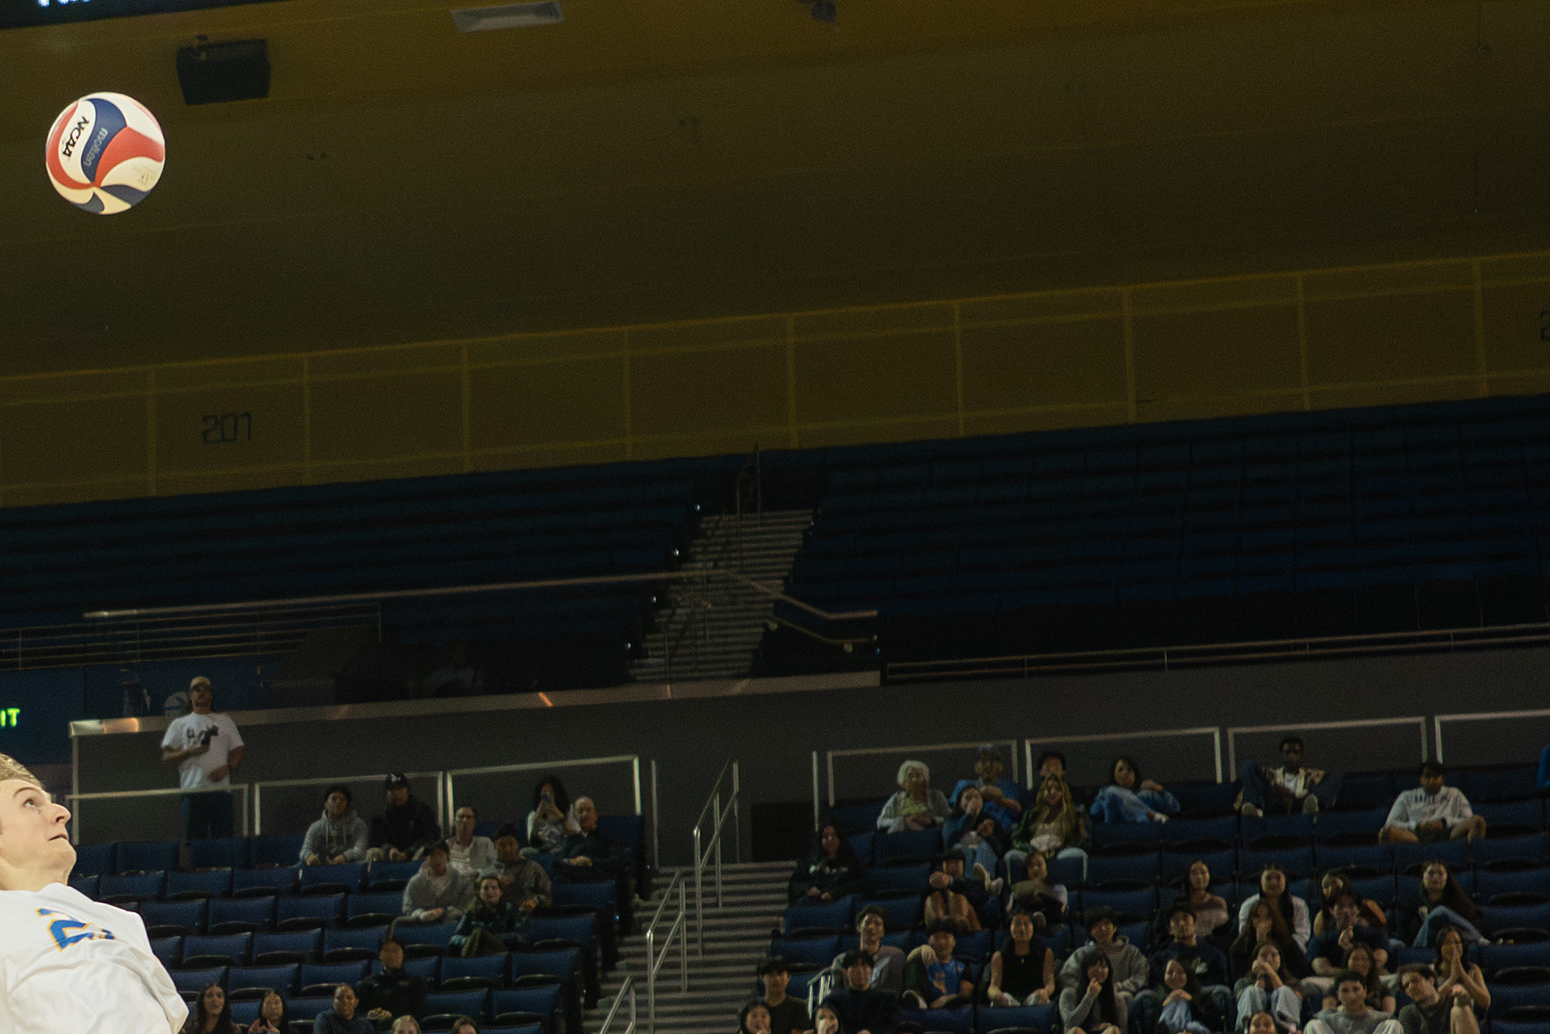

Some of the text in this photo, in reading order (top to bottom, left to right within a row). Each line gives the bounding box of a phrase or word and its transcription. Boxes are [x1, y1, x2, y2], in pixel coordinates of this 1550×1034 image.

[62, 116, 89, 158] NCAA
[84, 127, 108, 166] molten
[203, 412, 252, 444] 201
